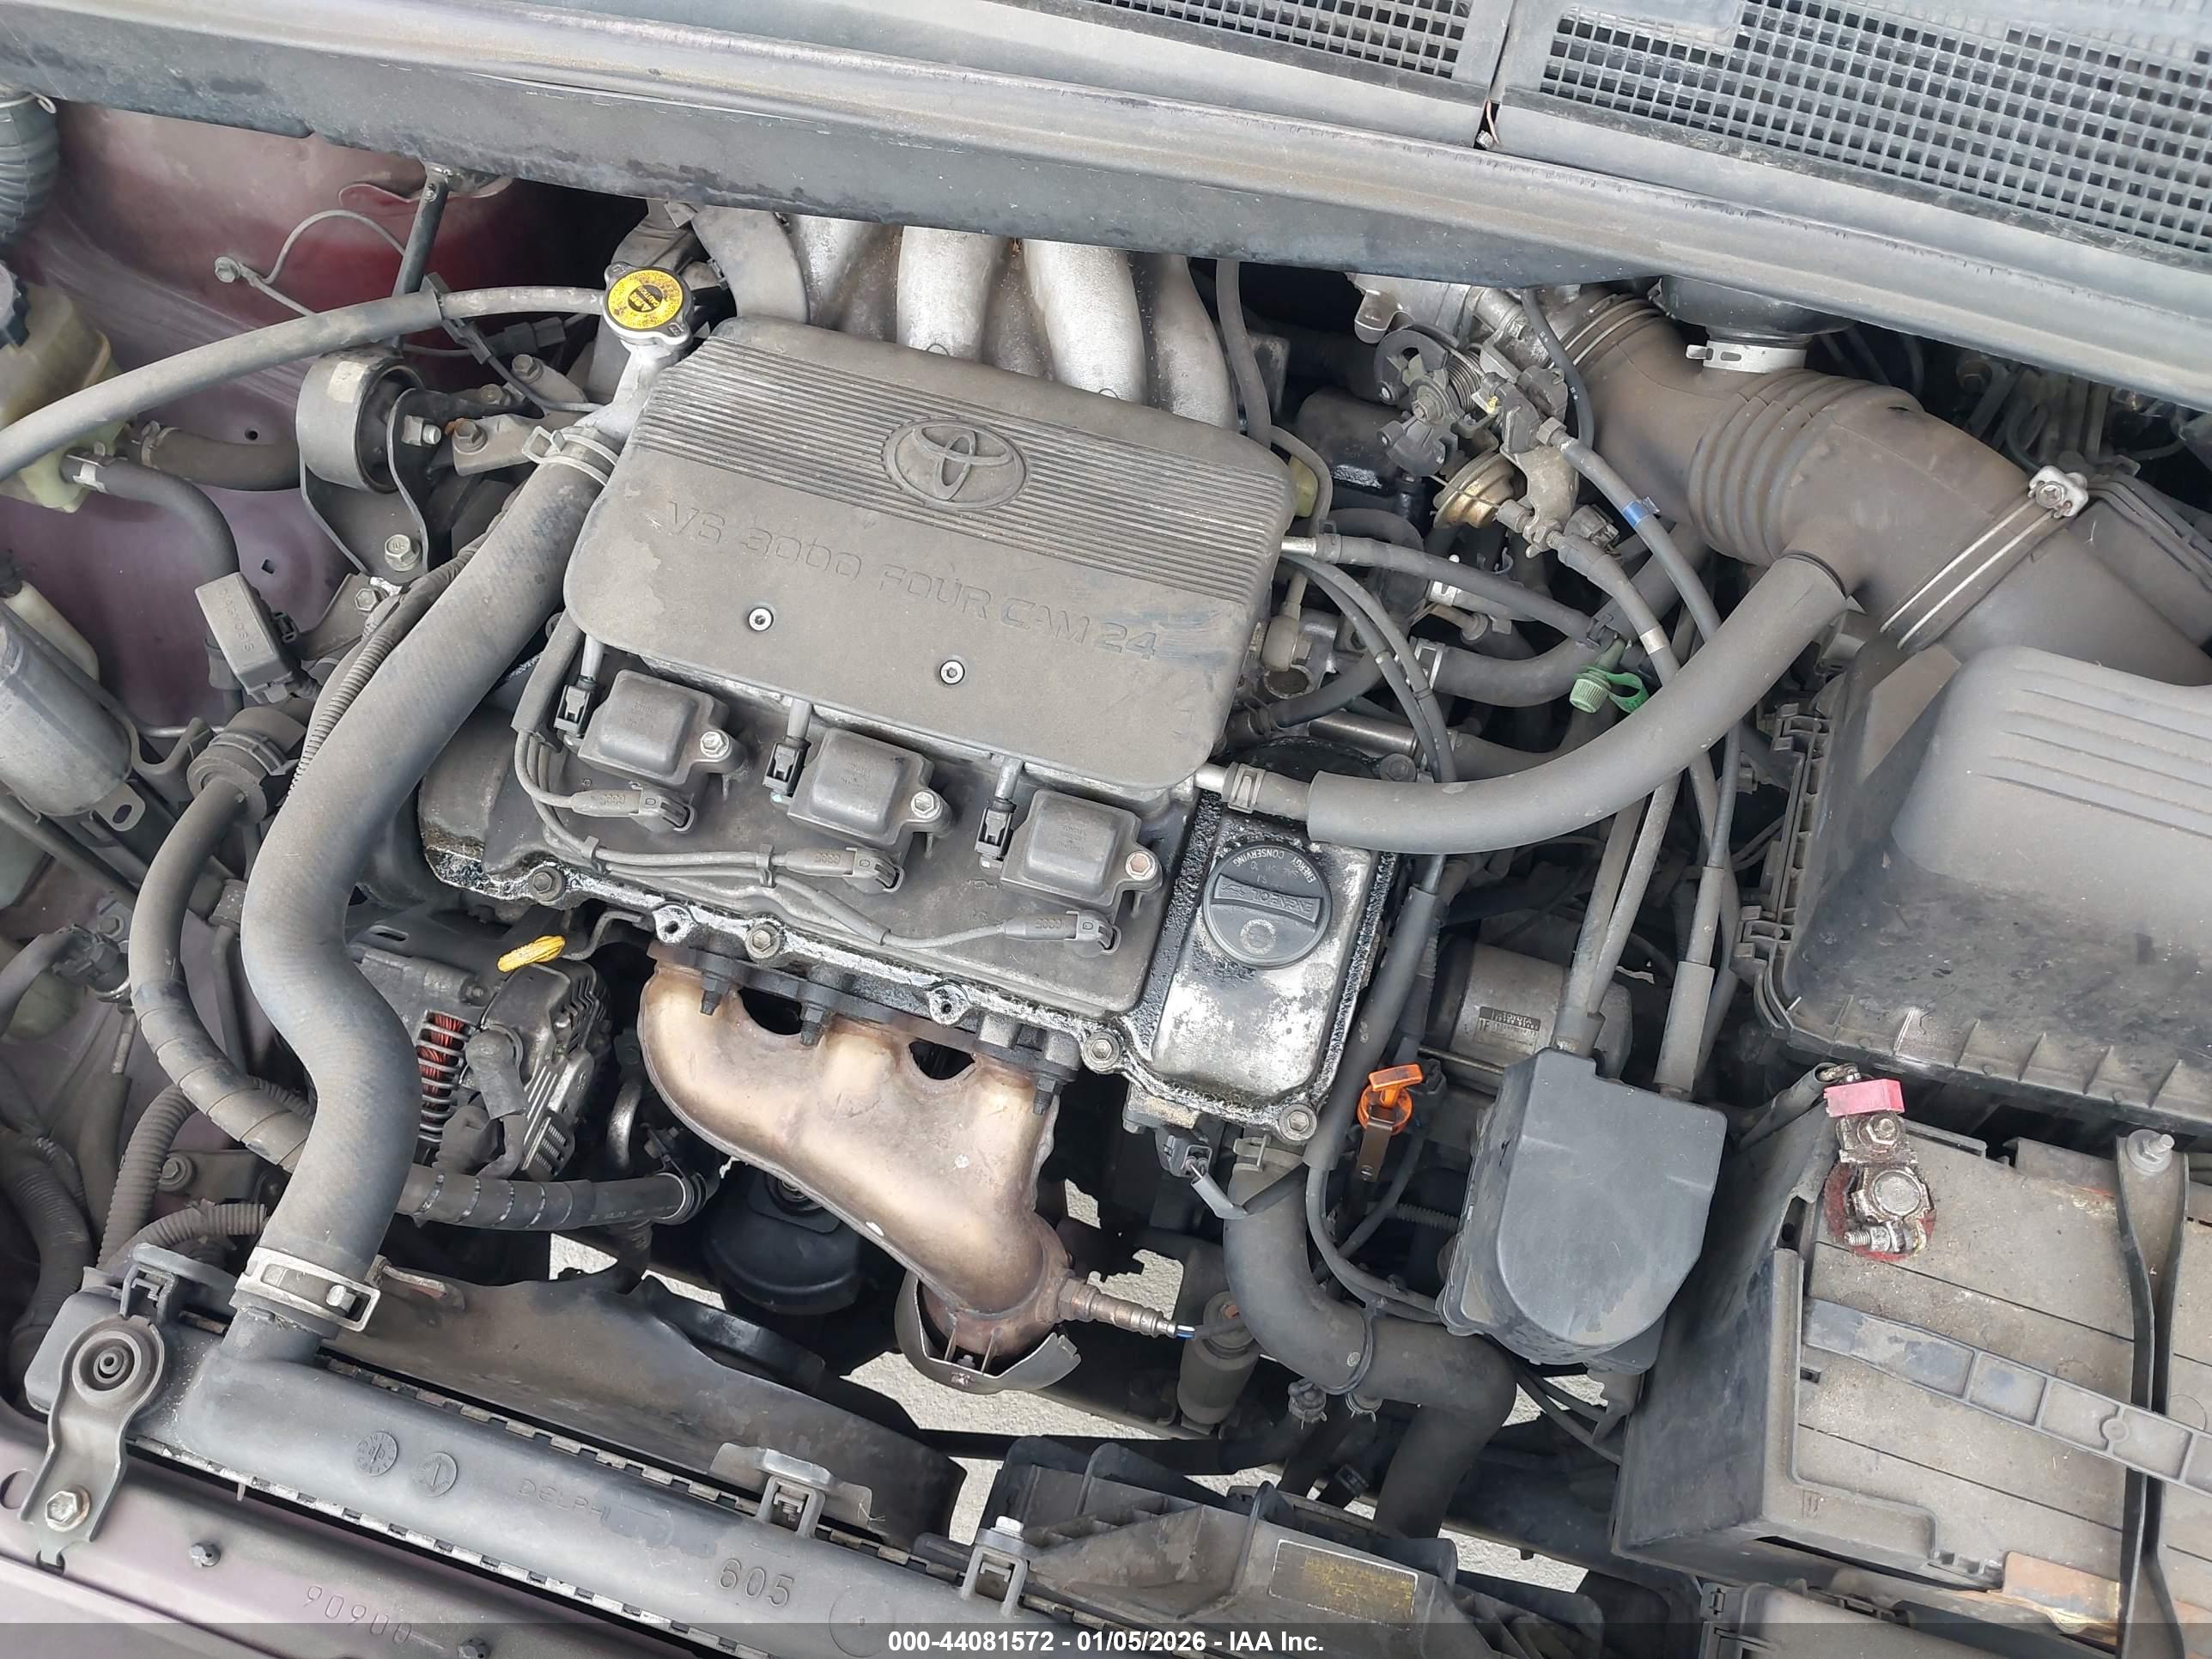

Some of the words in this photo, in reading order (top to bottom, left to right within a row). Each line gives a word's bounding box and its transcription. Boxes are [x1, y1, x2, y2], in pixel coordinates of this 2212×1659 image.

[668, 500, 726, 544] V6
[739, 526, 862, 582] 3000
[879, 562, 992, 620] FOUR
[1000, 597, 1091, 645] CAM
[1098, 622, 1158, 660] 24
[1232, 848, 1285, 866] CONSERVING
[1291, 857, 1316, 884] ENERGY
[1501, 1012, 1533, 1024] TOYOTA
[517, 1477, 611, 1523] DELPHI
[718, 1558, 795, 1608] 605
